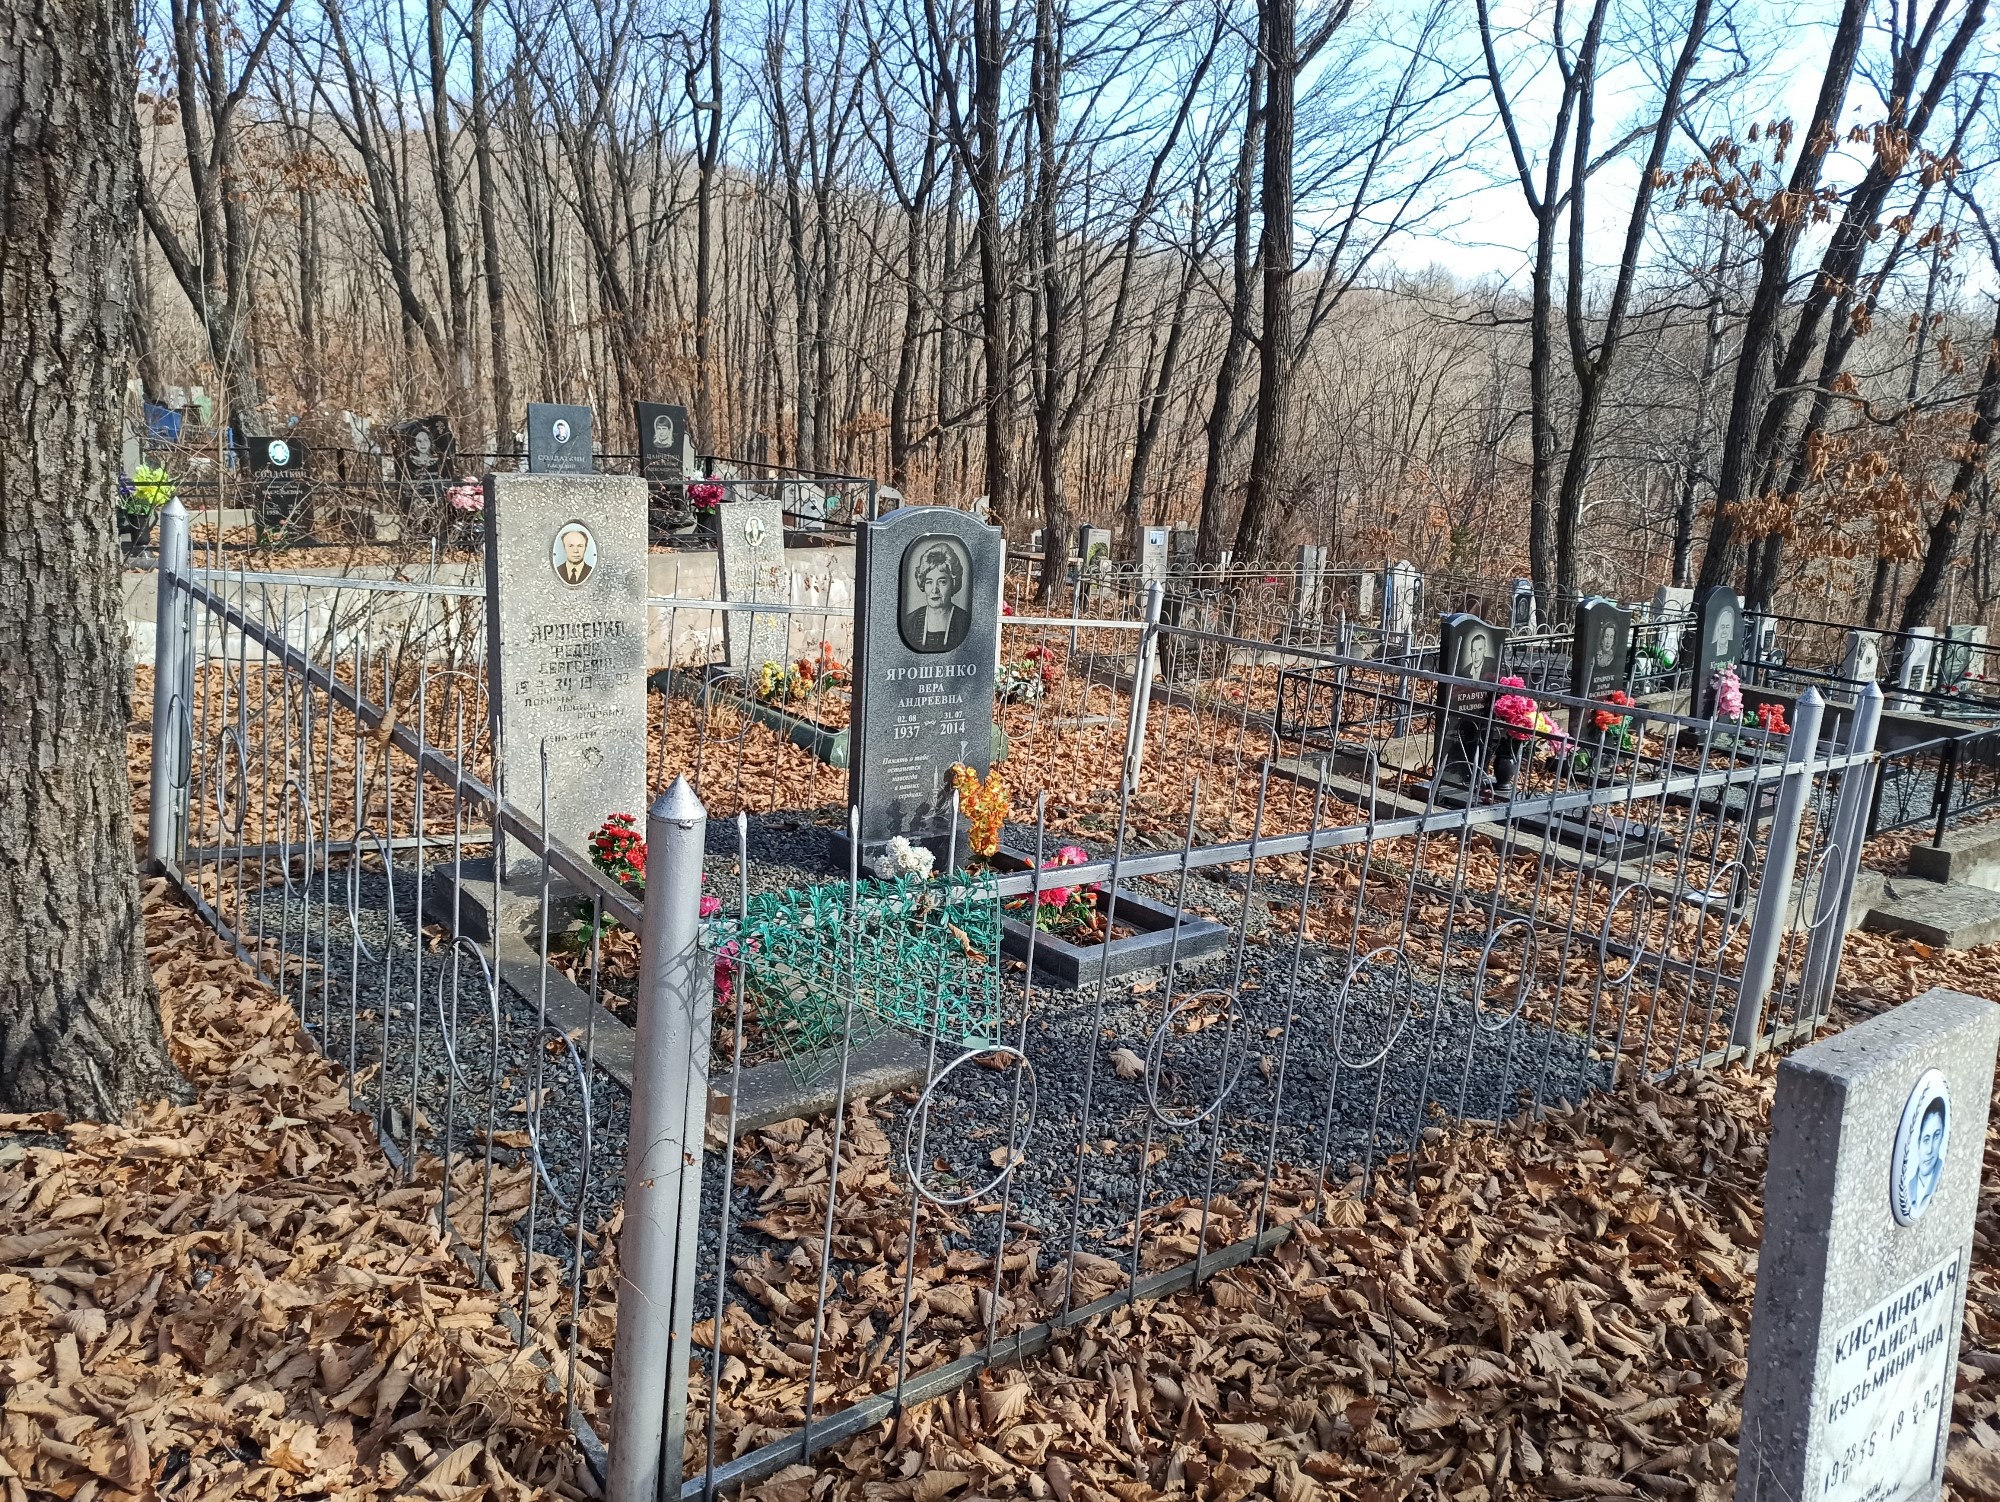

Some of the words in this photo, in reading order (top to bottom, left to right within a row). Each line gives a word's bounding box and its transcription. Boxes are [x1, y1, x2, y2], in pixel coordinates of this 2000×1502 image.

[885, 663, 977, 681] ЯРОШЕНКО
[918, 683, 945, 694] ВЕРА
[898, 694, 963, 708] АНДРЕЕВНА
[893, 726, 920, 740] 1937
[940, 721, 966, 735] 2014
[1835, 1260, 1957, 1364] КИСЛИНСКАЯ
[1867, 1316, 1918, 1371] РАИСА
[1828, 1323, 1943, 1424] КУЗЬМИНИЧНА
